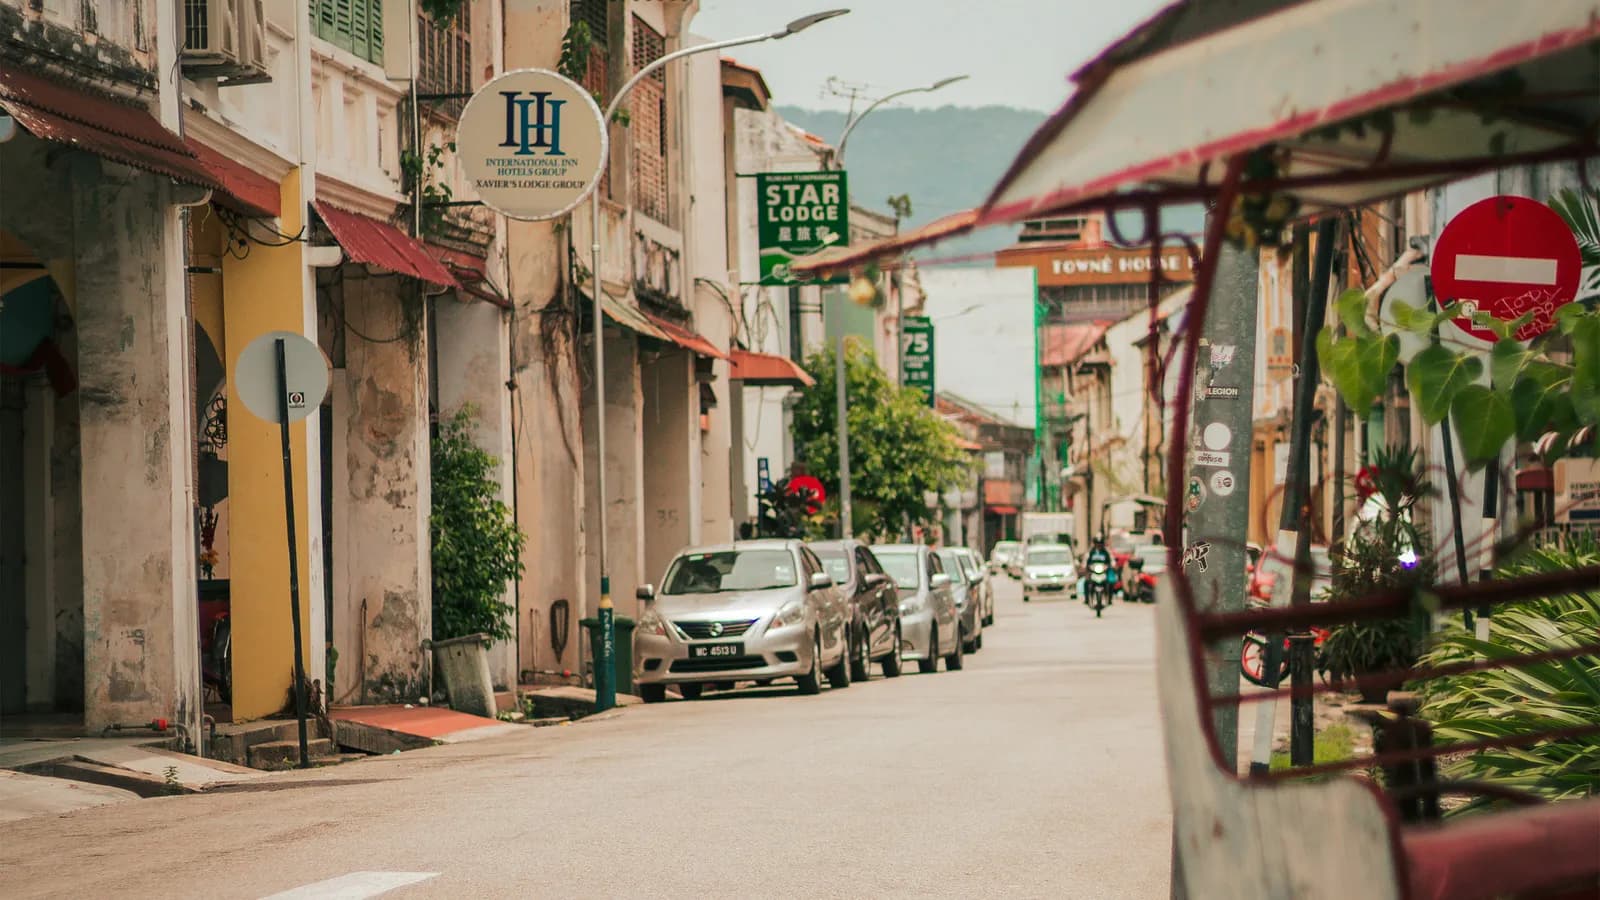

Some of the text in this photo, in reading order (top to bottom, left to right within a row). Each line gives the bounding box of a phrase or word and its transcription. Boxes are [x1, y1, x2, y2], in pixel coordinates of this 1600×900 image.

[485, 158, 559, 167] INTERNATIONAL
[497, 167, 567, 176] HOTELS GROUP
[476, 179, 585, 188] XAVIER'S LODGE GROUP
[766, 184, 840, 205] STAR
[768, 205, 839, 222] LODGE
[903, 333, 929, 353] 75
[1208, 387, 1238, 396] LEGION
